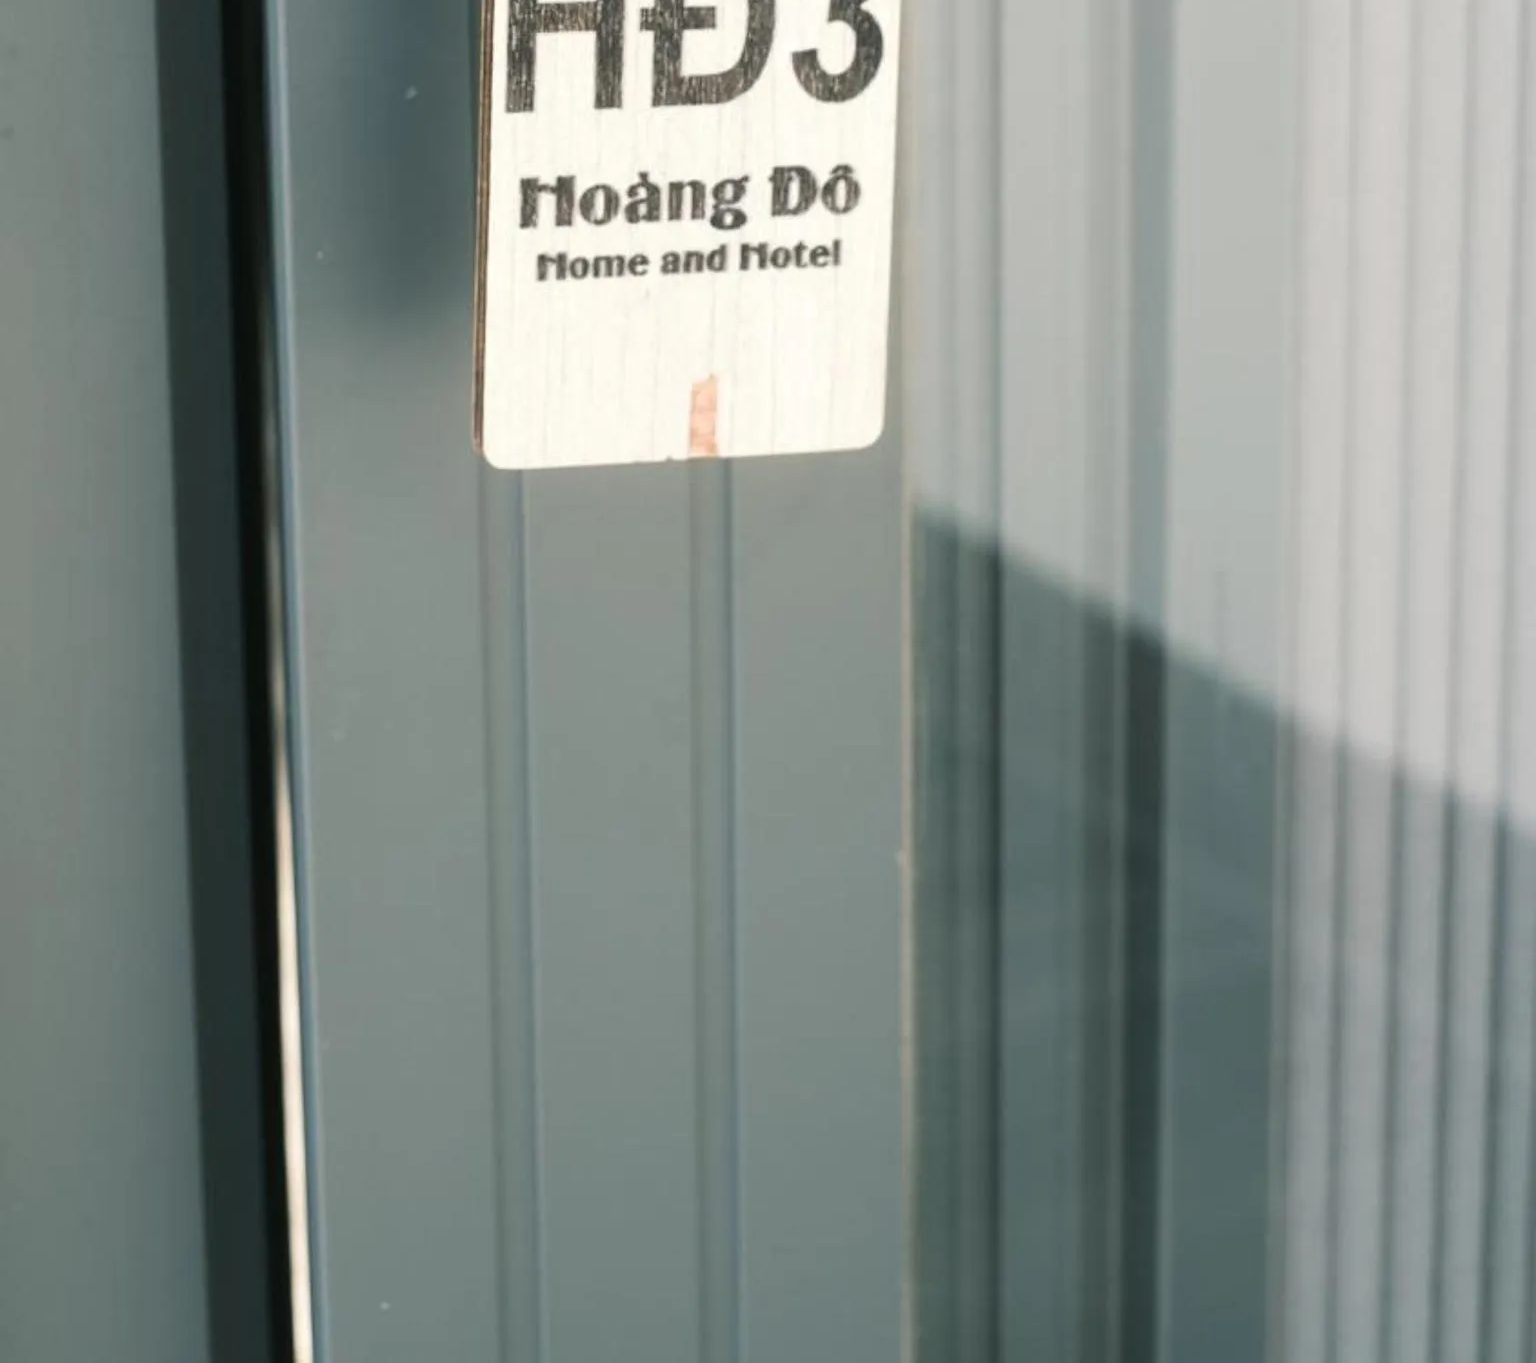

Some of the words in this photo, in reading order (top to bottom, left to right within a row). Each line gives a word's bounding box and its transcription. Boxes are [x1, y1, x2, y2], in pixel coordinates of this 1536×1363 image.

[519, 171, 750, 231] Hoàng
[768, 164, 861, 217] Đô
[536, 252, 650, 282] Home
[660, 244, 728, 275] and
[739, 239, 842, 271] Hotel
